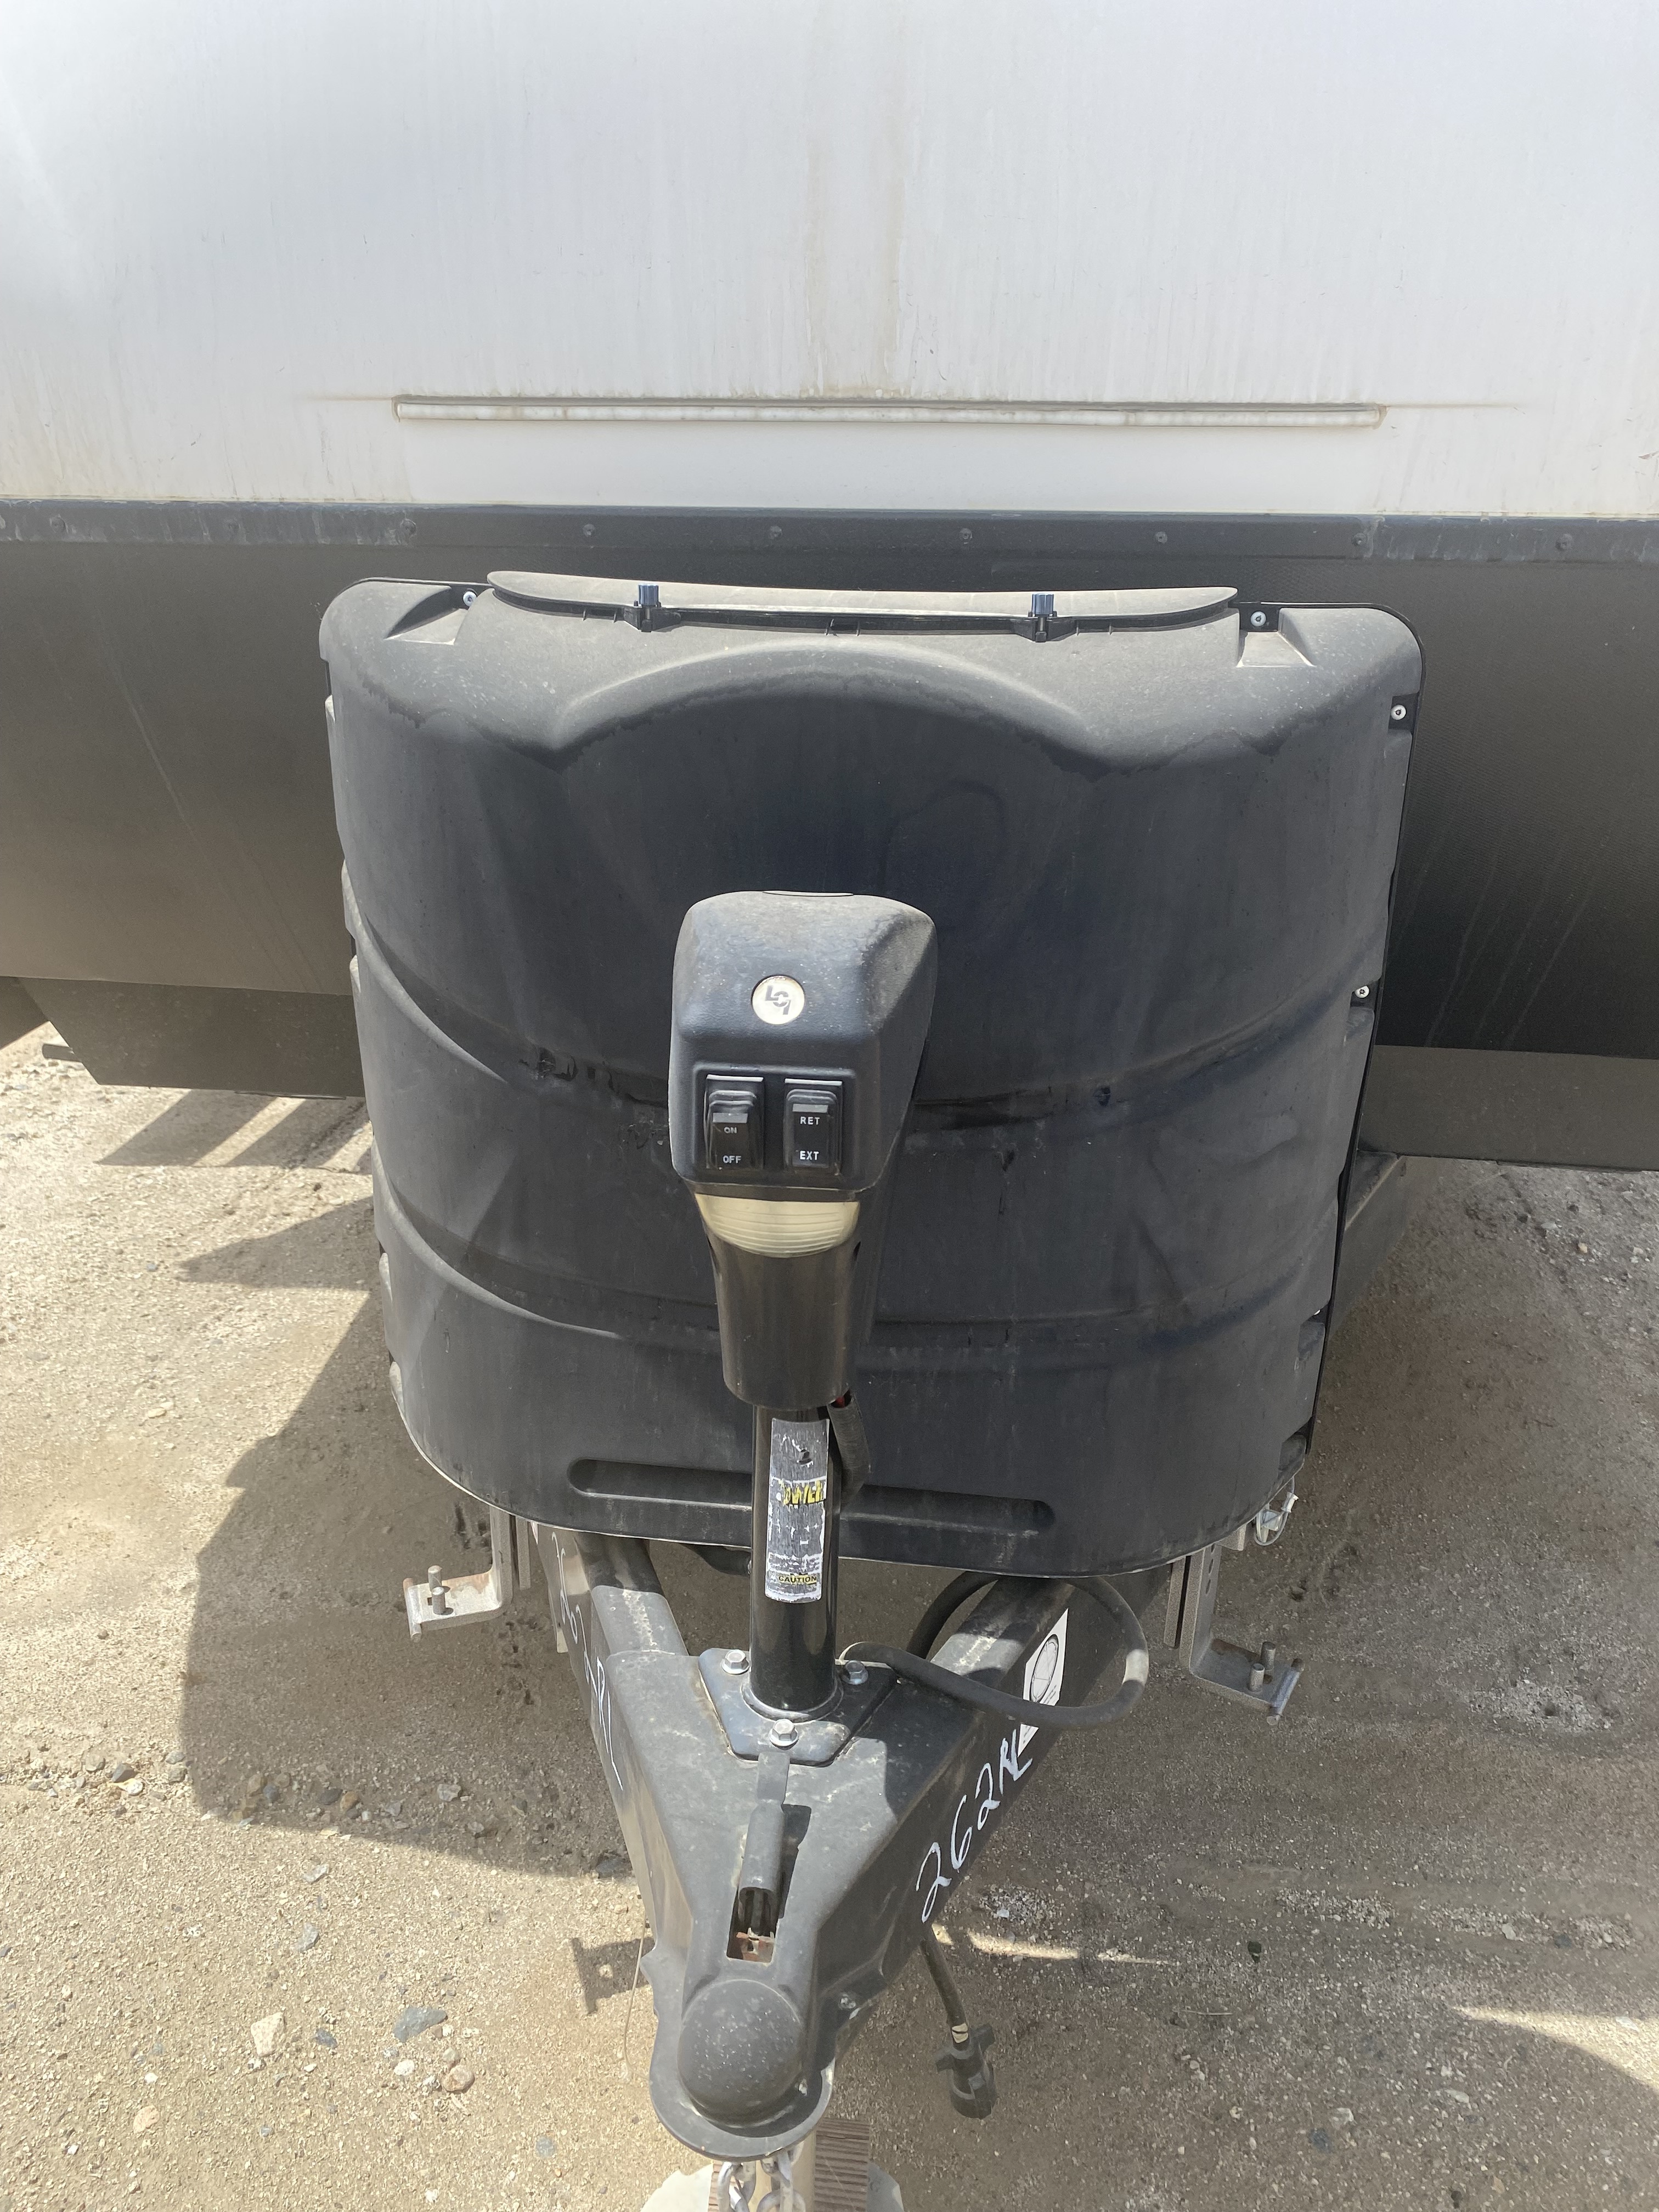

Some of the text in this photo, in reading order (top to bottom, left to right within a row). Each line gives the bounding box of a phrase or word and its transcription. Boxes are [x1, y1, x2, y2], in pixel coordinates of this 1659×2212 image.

[800, 1116, 820, 1125] RET
[723, 1155, 741, 1164] OFF
[799, 1150, 819, 1160] EXT
[777, 1480, 823, 1505] OWER
[778, 1575, 817, 1583] CAUTION
[915, 1728, 1033, 1923] 262RL
